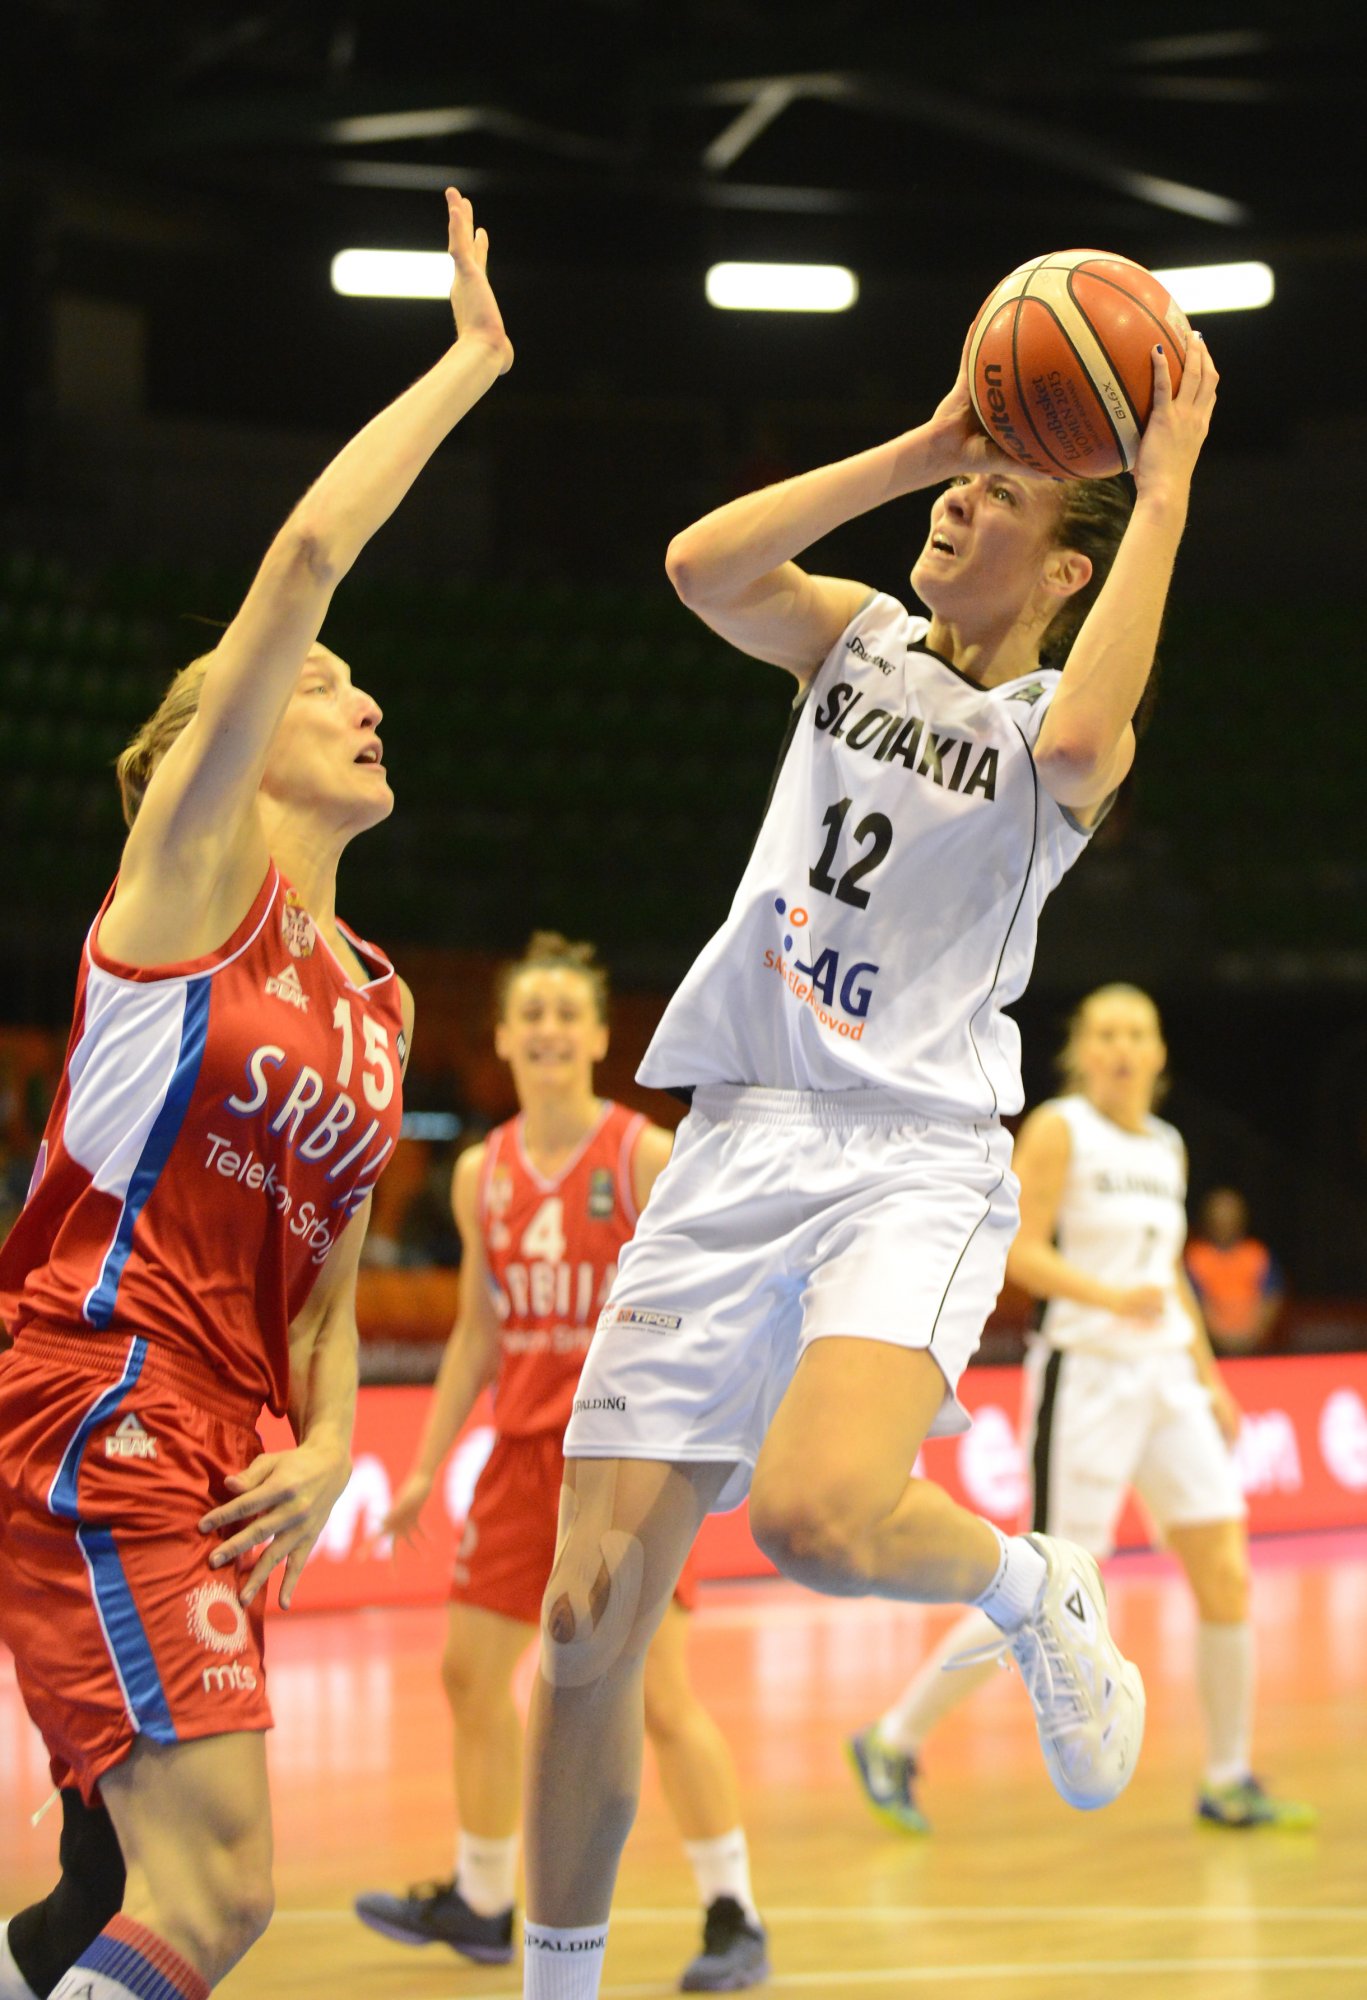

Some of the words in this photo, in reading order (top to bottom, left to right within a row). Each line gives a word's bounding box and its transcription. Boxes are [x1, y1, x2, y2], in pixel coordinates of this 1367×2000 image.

[1047, 370, 1069, 405] 2015
[1032, 375, 1082, 461] EuroBasket
[1060, 408, 1094, 457] WOMEN
[809, 797, 893, 911] 12
[265, 976, 310, 1014] PEAK
[333, 997, 395, 1111] 15
[520, 1197, 567, 1266] 4
[574, 1395, 627, 1413] PALDING
[105, 1436, 158, 1460] PEAK
[203, 1659, 257, 1694] mts
[524, 1934, 607, 1952] PALDIN
